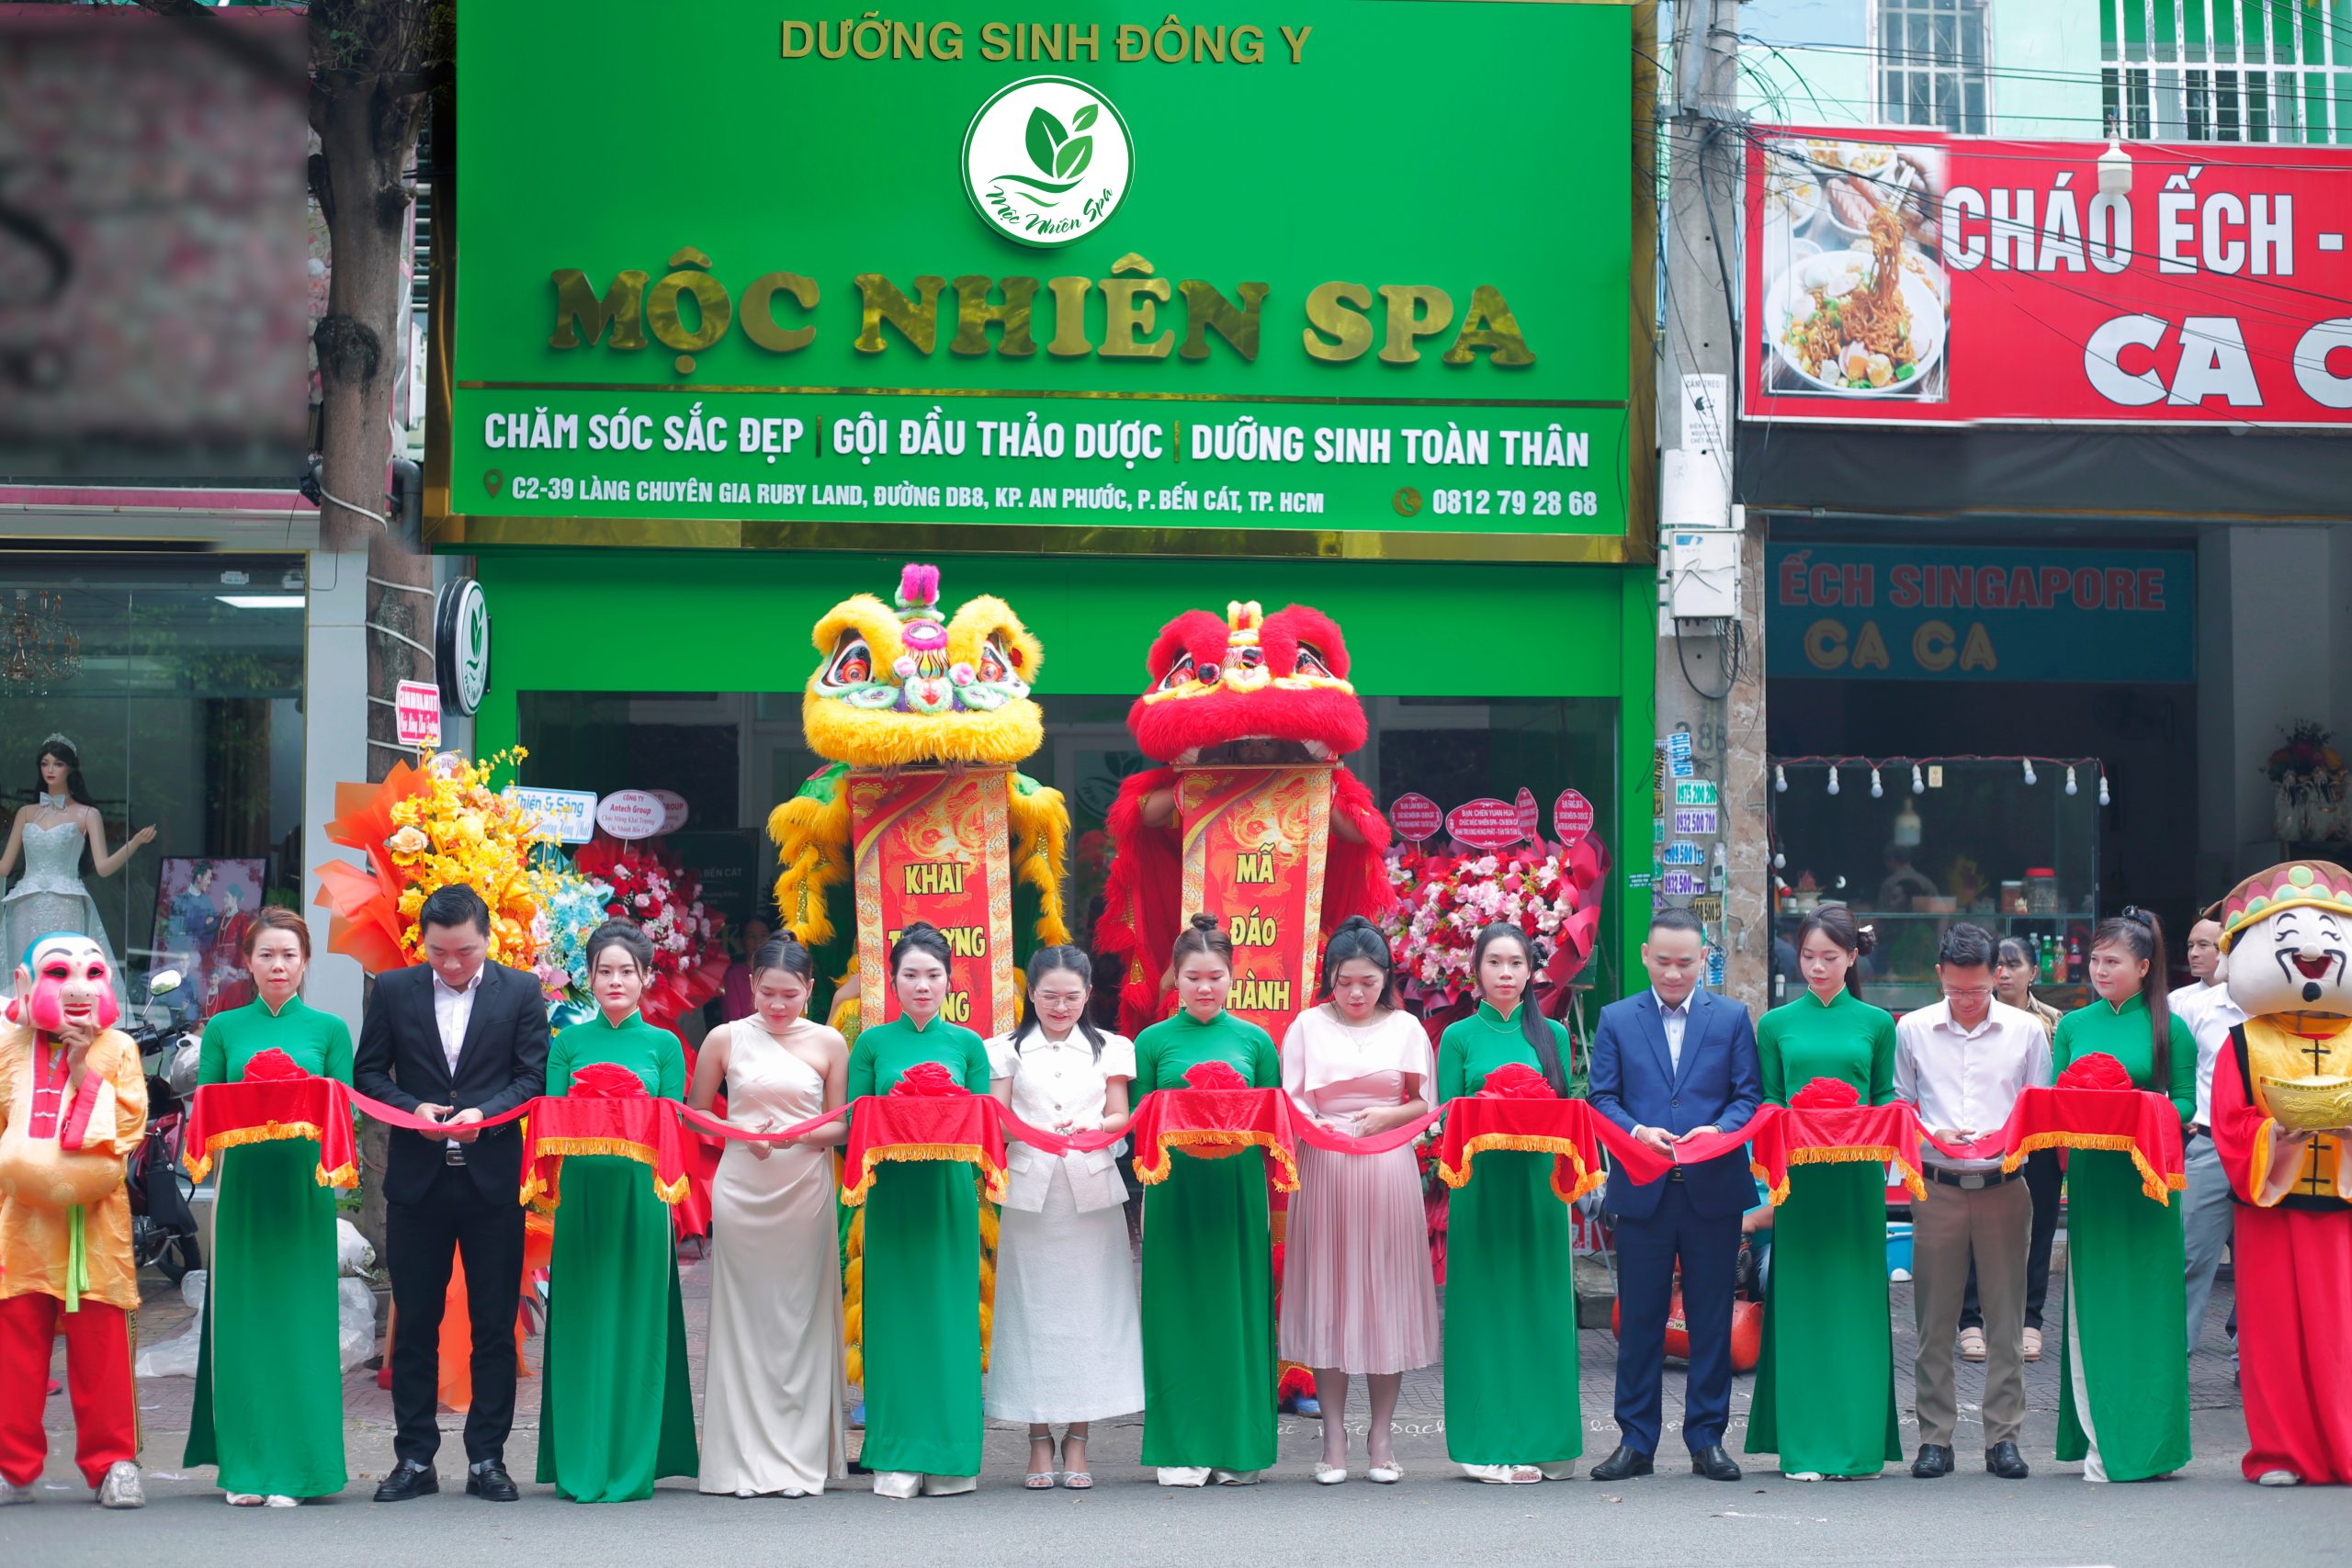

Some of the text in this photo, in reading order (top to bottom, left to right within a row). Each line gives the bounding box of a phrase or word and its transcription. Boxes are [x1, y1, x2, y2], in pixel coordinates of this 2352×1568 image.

[780, 10, 1313, 64] DƯỠNG SINH ĐÔNG Y
[986, 185, 1114, 235] Mộc Nhiên Spa
[1940, 171, 2133, 275] CHÁO
[2156, 164, 2295, 276] ẾCH
[548, 245, 1538, 376] MỘC NHIÊN SPA
[2083, 311, 2265, 407] CA
[484, 401, 805, 465] CHĂM SÓC SẮC ĐẸP
[832, 405, 1163, 470] GỘI ĐẦU THẢO DƯỢC
[1192, 415, 1589, 468] DƯỠNG SINH TOÀN THÂN
[512, 475, 1324, 513] C2-39 LÀNG CHUYÊN GIA RUBY LAND, ĐƯỜNG DB8, KP. AN PHƯỚC, P. BẾN CÁT, TP. HCM
[1432, 489, 1599, 517] 0812 79 28 68
[1779, 549, 2166, 611] ẾCH SINGAPORE
[1804, 617, 1999, 671] CA CA
[610, 804, 651, 817] Antech Group
[622, 794, 637, 802] CÔNG
[903, 863, 965, 896] KHAI
[1235, 842, 1276, 885] MÃ
[888, 926, 987, 958] TNG
[1229, 905, 1278, 948] ĐÁO
[1226, 969, 1292, 1011] HÀNH
